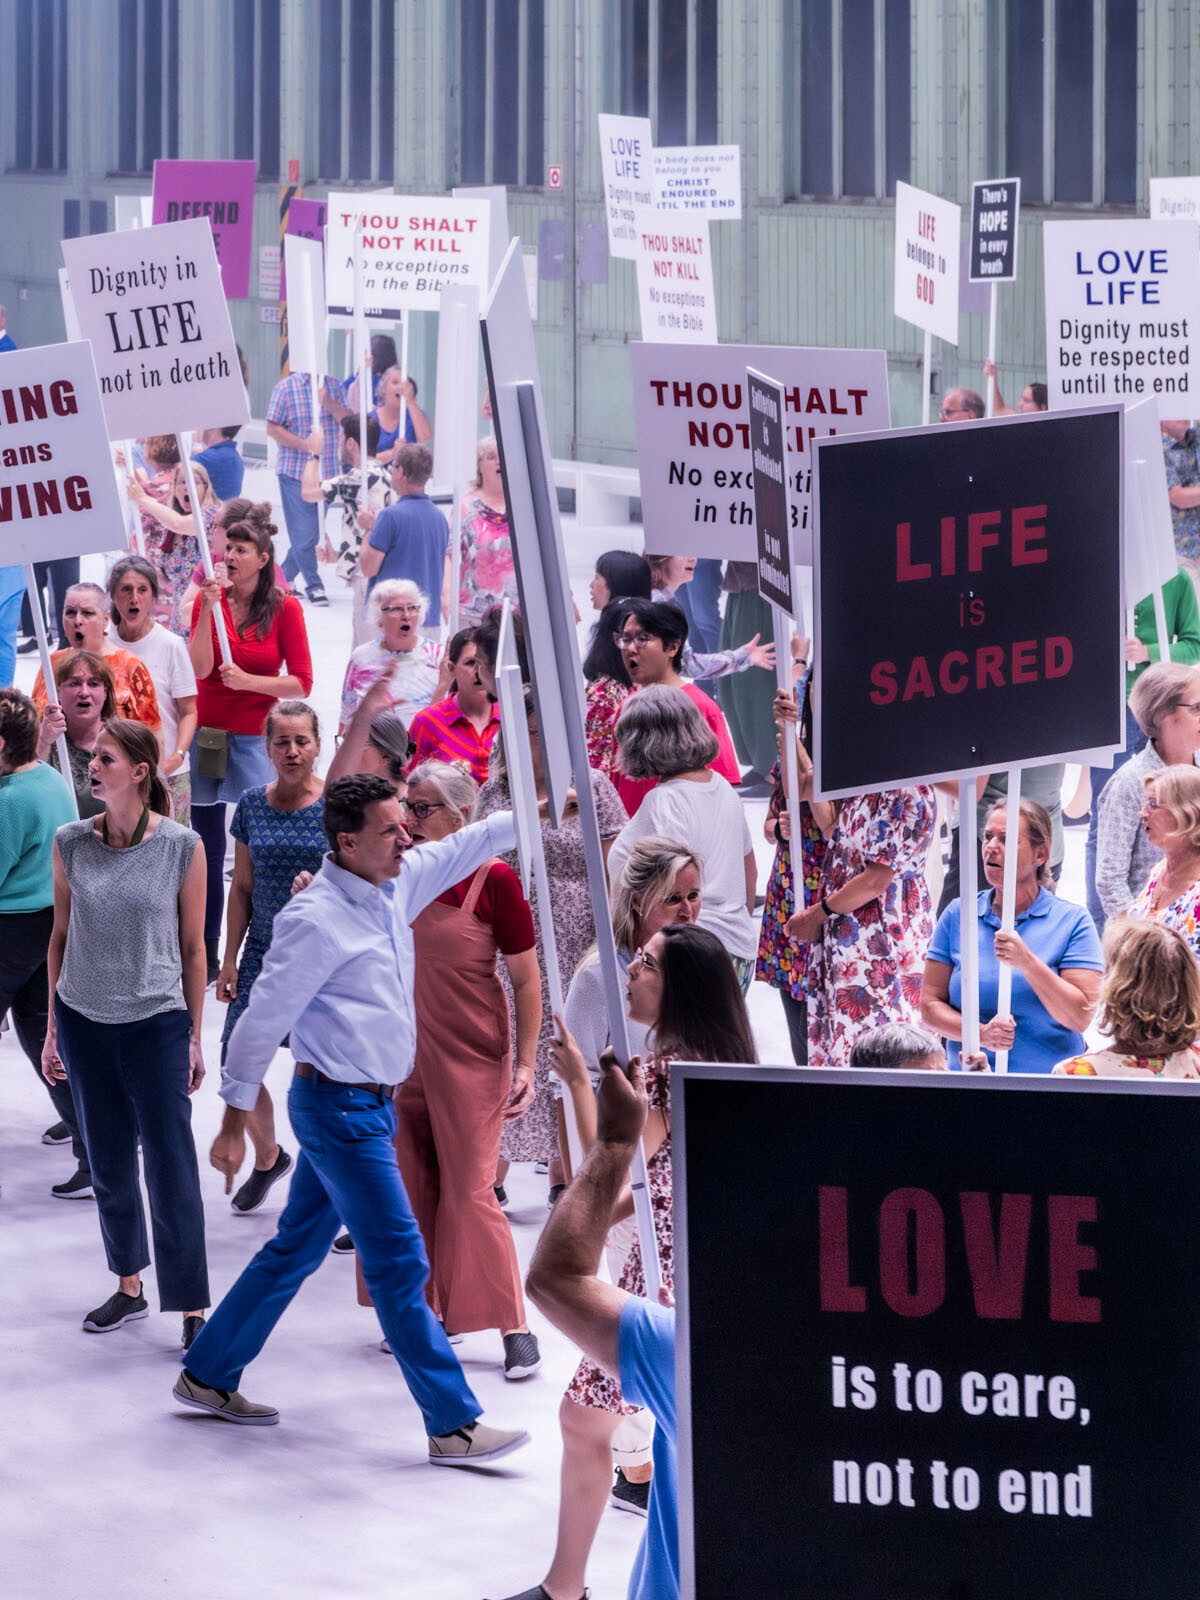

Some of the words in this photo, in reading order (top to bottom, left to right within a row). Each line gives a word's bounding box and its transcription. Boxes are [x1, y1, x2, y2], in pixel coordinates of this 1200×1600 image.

[610, 138, 641, 157] LOVE
[615, 159, 640, 179] LIFE
[661, 189, 717, 198] ENDURED
[667, 178, 710, 187] CHRIST
[684, 200, 706, 209] THE
[712, 200, 735, 208] END
[982, 188, 1007, 204] There's
[1160, 197, 1196, 216] Dignity
[167, 201, 239, 224] DEFEND
[409, 217, 477, 232] SHALT
[980, 210, 1008, 232] HOPE
[919, 210, 935, 242] LIFE
[362, 236, 405, 250] NOT
[414, 238, 461, 252] KILL
[642, 234, 668, 252] THOU
[672, 236, 703, 254] SHALT
[988, 240, 1008, 256] every
[376, 260, 469, 275] exceptions
[653, 260, 672, 278] NOT
[676, 261, 699, 280] KILL
[980, 258, 1003, 275] breath
[1076, 250, 1168, 275] LOVE
[90, 261, 167, 297] Dignity
[176, 255, 198, 280] in
[383, 277, 408, 290] the
[917, 273, 934, 305] GOD
[1086, 281, 1160, 305] LIFE
[105, 300, 202, 353] LIFE
[1060, 319, 1130, 344] Dignity
[1140, 319, 1188, 338] must
[1060, 347, 1082, 367] be
[1091, 345, 1189, 371] respected
[101, 368, 132, 394] not
[141, 363, 162, 389] in
[170, 352, 230, 385] death
[1062, 374, 1105, 394] until
[1114, 374, 1144, 393] the
[1153, 373, 1188, 393] end
[650, 381, 742, 409] THOU
[784, 387, 868, 416] HALT
[688, 421, 750, 450] NOT
[669, 461, 702, 486] No
[695, 498, 717, 523] in
[896, 504, 1048, 582] LIFE
[960, 592, 985, 627] is
[869, 636, 1074, 706] SACRED
[818, 1185, 1101, 1324] LOVE
[832, 1355, 877, 1410] is
[893, 1362, 943, 1413] to
[960, 1370, 1091, 1426] care,
[833, 1457, 915, 1507] not
[930, 1460, 980, 1511] to
[998, 1464, 1092, 1518] end
